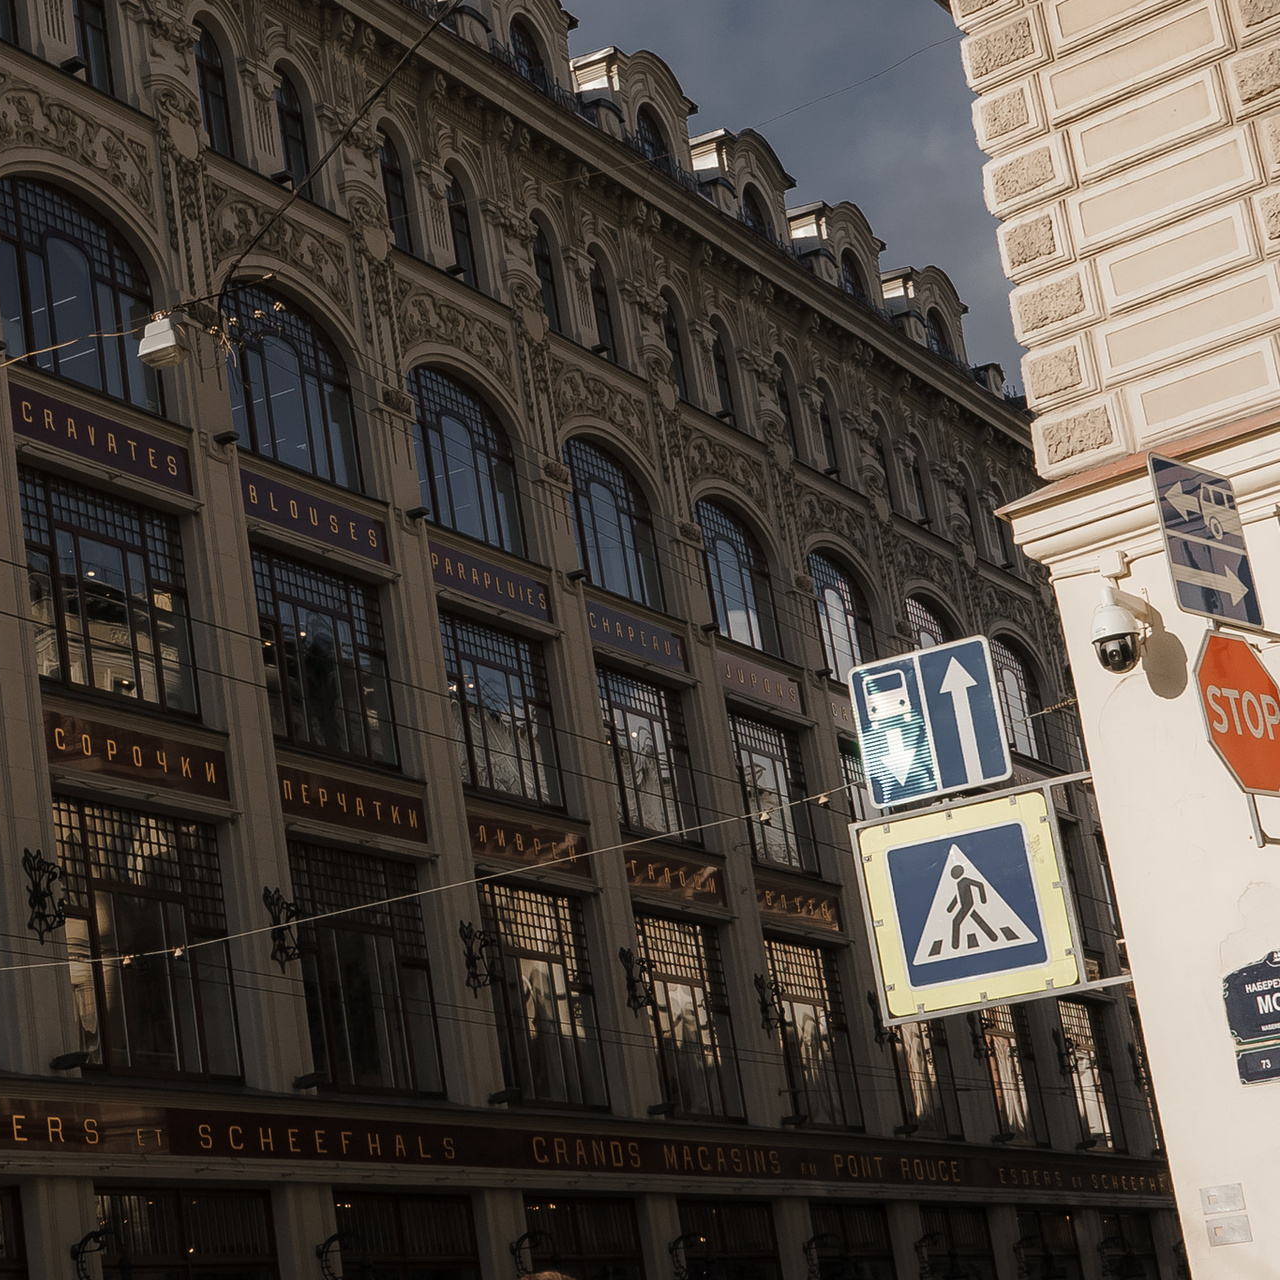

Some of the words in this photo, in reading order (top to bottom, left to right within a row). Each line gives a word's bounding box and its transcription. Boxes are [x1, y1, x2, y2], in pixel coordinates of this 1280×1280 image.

[22, 401, 179, 477] CRAVATES
[248, 483, 379, 549] BLOUSES
[431, 552, 547, 610] PARAPLUIES
[589, 612, 684, 661] CHAPEAUX
[725, 664, 796, 703] JUPONS
[1206, 684, 1280, 741] STOP
[54, 727, 216, 785] СОРОЧКИ
[283, 779, 418, 829] ПЕРЧАТКИ
[479, 824, 577, 863] ЛИВРЕИ
[630, 859, 716, 894] ГАЛОШИ
[1245, 978, 1280, 993] НАБЕРЕ
[1261, 1059, 1271, 1069] 73
[136, 1127, 163, 1147] ET
[198, 1124, 457, 1159] SCHEEFHALS
[532, 1135, 642, 1169] GRANDS
[663, 1143, 782, 1175] MAGASINS
[800, 1161, 818, 1177] AU
[834, 1154, 884, 1179] PONT
[900, 1157, 962, 1182] ROUGE
[999, 1167, 1063, 1188] ESDERS
